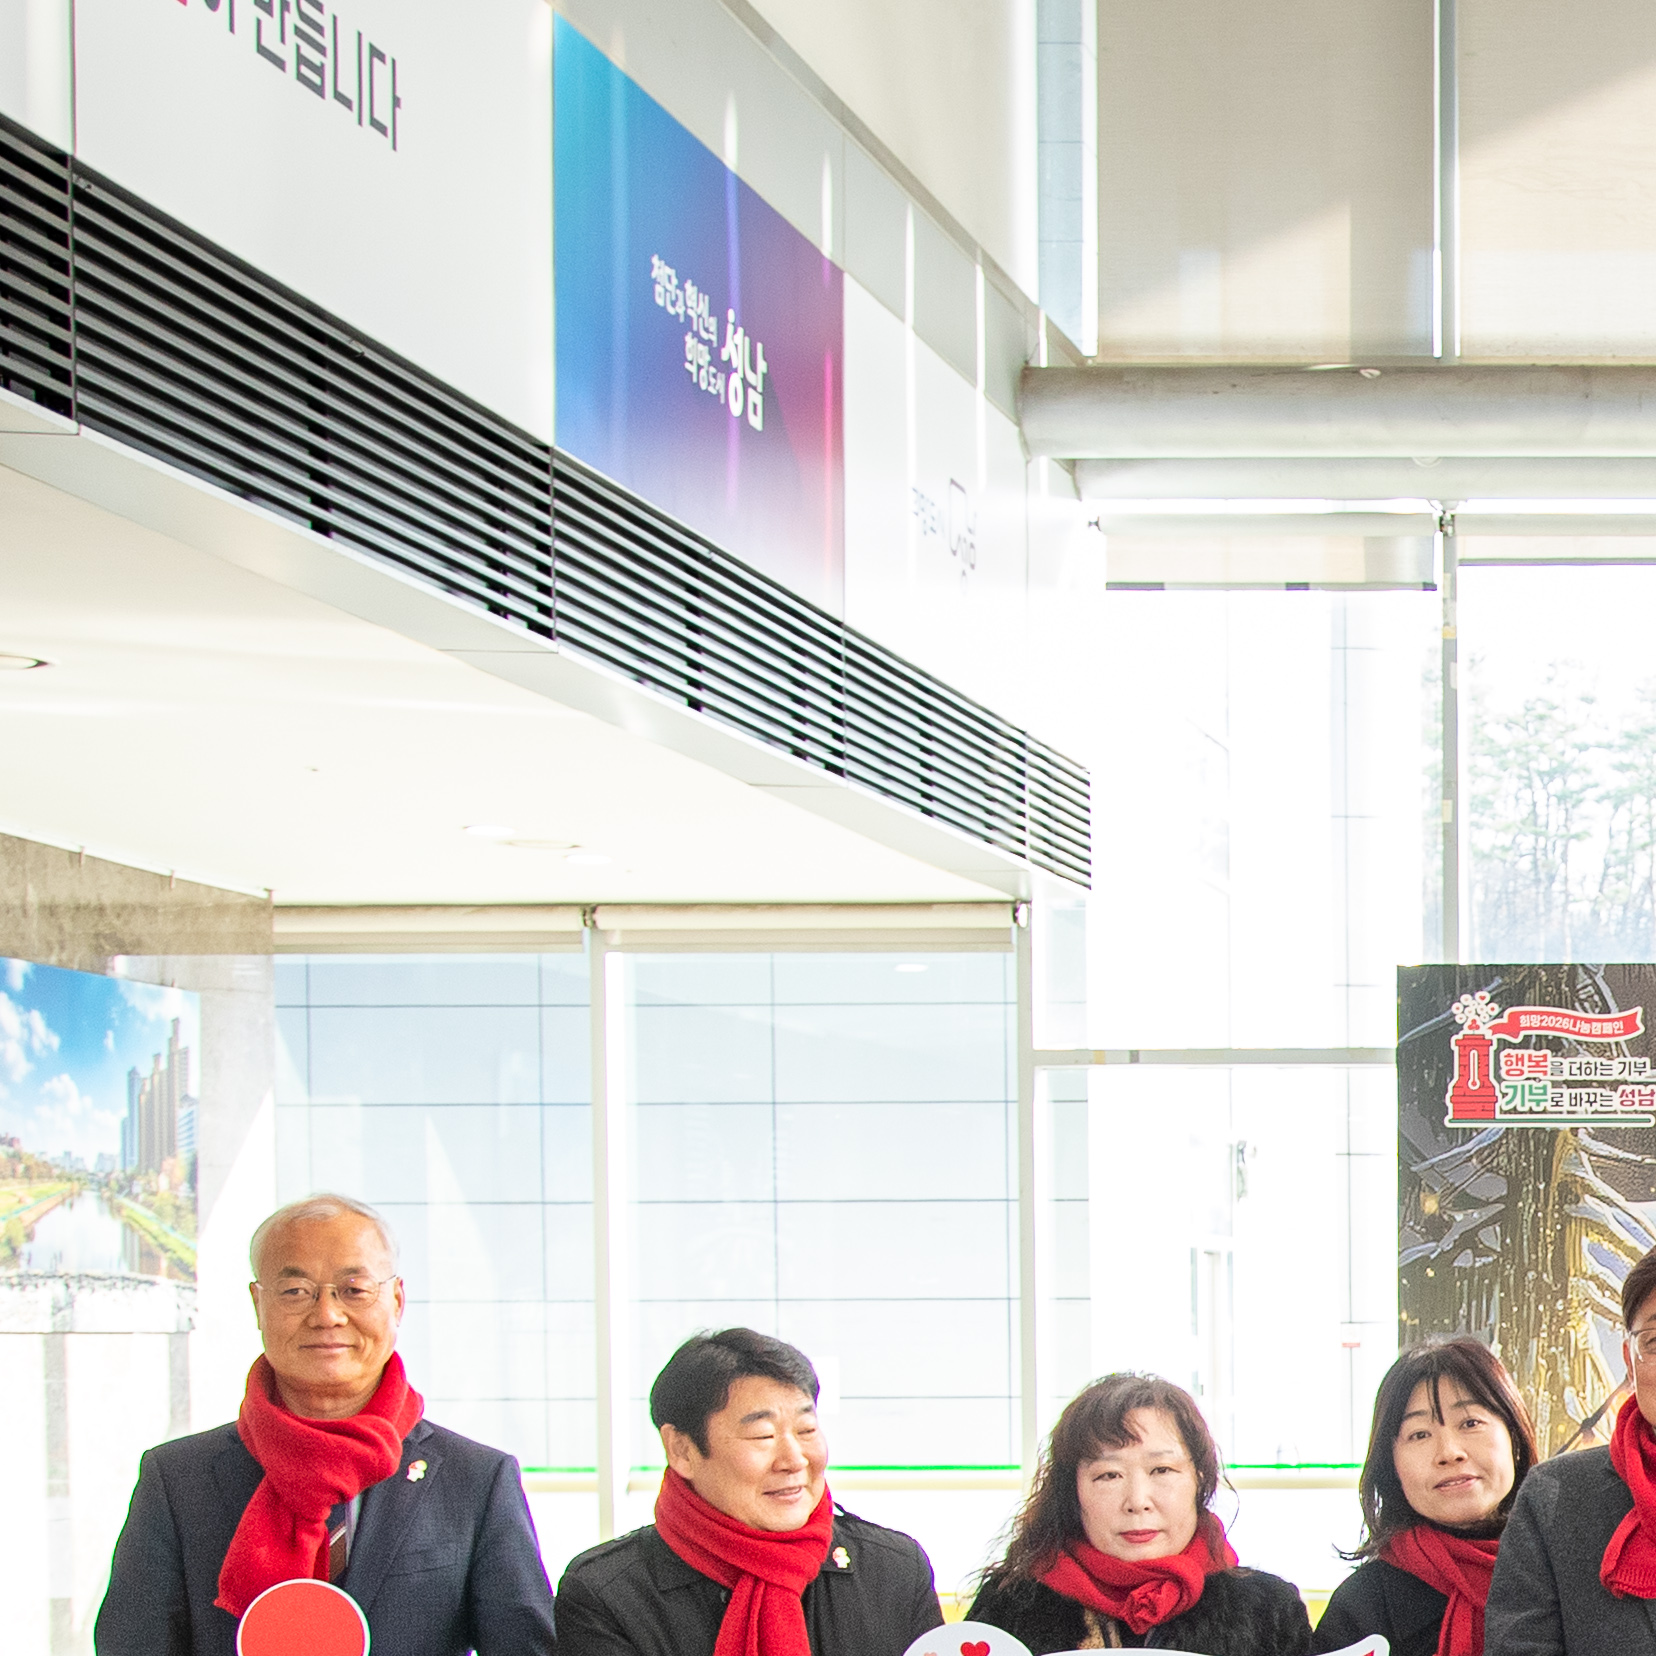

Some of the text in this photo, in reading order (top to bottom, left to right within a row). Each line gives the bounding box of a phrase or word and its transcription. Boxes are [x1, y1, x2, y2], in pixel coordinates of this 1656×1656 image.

[651, 254, 718, 348] 첨단과 혁신의
[684, 331, 726, 405] 희망도시
[720, 308, 768, 431] 성남
[1519, 1014, 1624, 1035] 희망2026나눔캠페인
[1503, 1052, 1648, 1077] 행복을 더하는 기부
[1504, 1083, 1656, 1108] 기부로 바꾸는 성남
